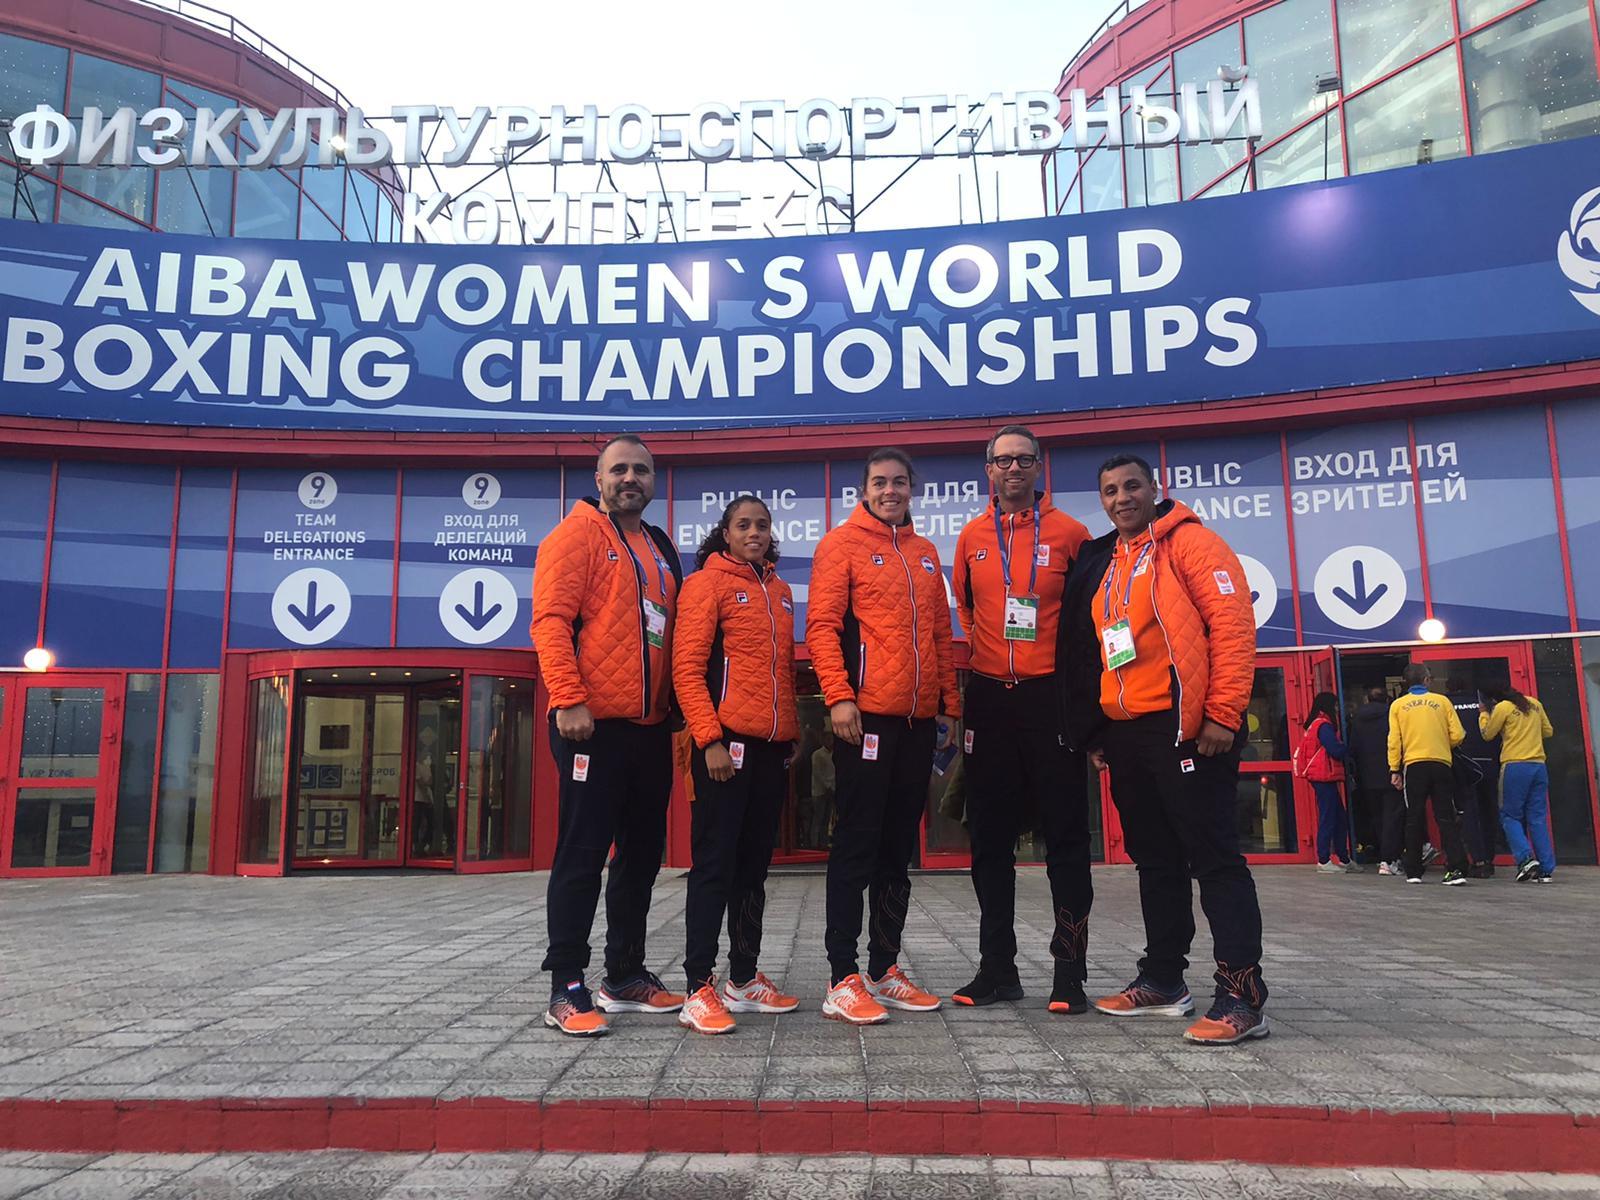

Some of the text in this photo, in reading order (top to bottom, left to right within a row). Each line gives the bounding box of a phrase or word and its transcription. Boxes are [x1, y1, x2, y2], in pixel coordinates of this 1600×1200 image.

[10, 64, 1263, 171] ФИЗКУЛЬТУРНО-СПОРТИВНЫЙ
[402, 185, 854, 246] КОМПЛЕКС
[74, 246, 317, 321] AIBA
[836, 227, 1184, 314] WORLD
[3, 296, 1259, 403] BOXING CHAMPIONSHIPS
[1294, 441, 1458, 480] ВХОД ДЛЯ
[311, 475, 326, 498] 9
[474, 476, 490, 499] 9
[920, 480, 979, 508] ДЛЯ
[1291, 471, 1468, 515] ЗРИТЕЛЕЙ
[295, 513, 337, 527] TEAM
[443, 514, 519, 528] ВХОД ДЛЯ
[263, 531, 366, 544] DELEGATIONS
[434, 529, 527, 546] ДЕЛЕГАЦИЙ
[273, 548, 354, 561] ENTRANCE
[448, 548, 513, 562] КОМАНД
